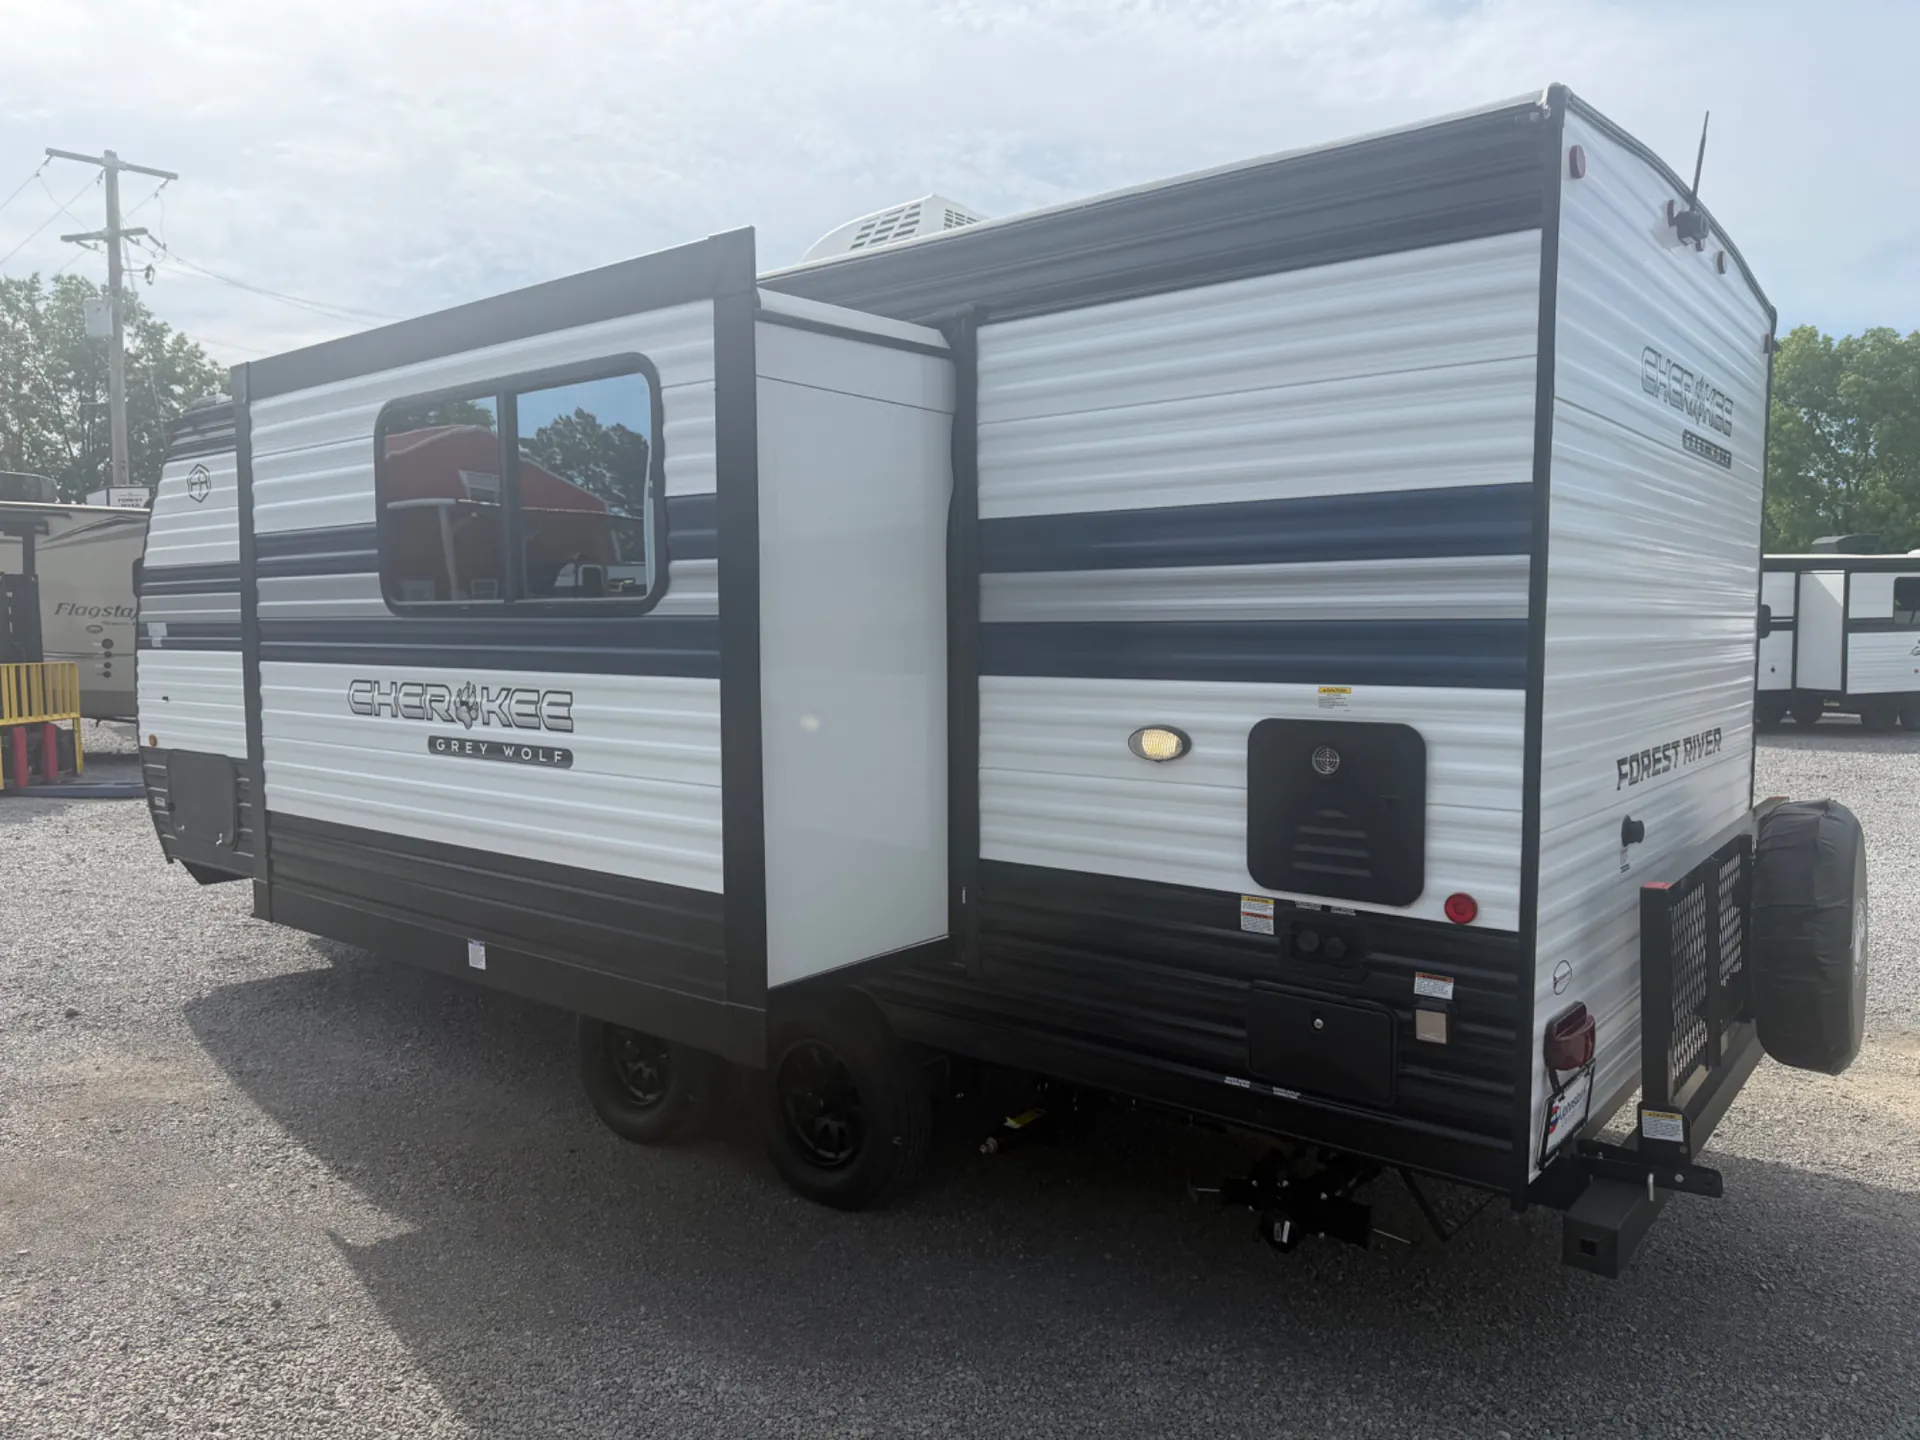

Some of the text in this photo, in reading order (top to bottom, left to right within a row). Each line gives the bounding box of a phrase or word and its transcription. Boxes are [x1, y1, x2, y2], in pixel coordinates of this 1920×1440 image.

[436, 739, 563, 763] GREY WOLF
[1616, 727, 1722, 792] FOREST RIVER
